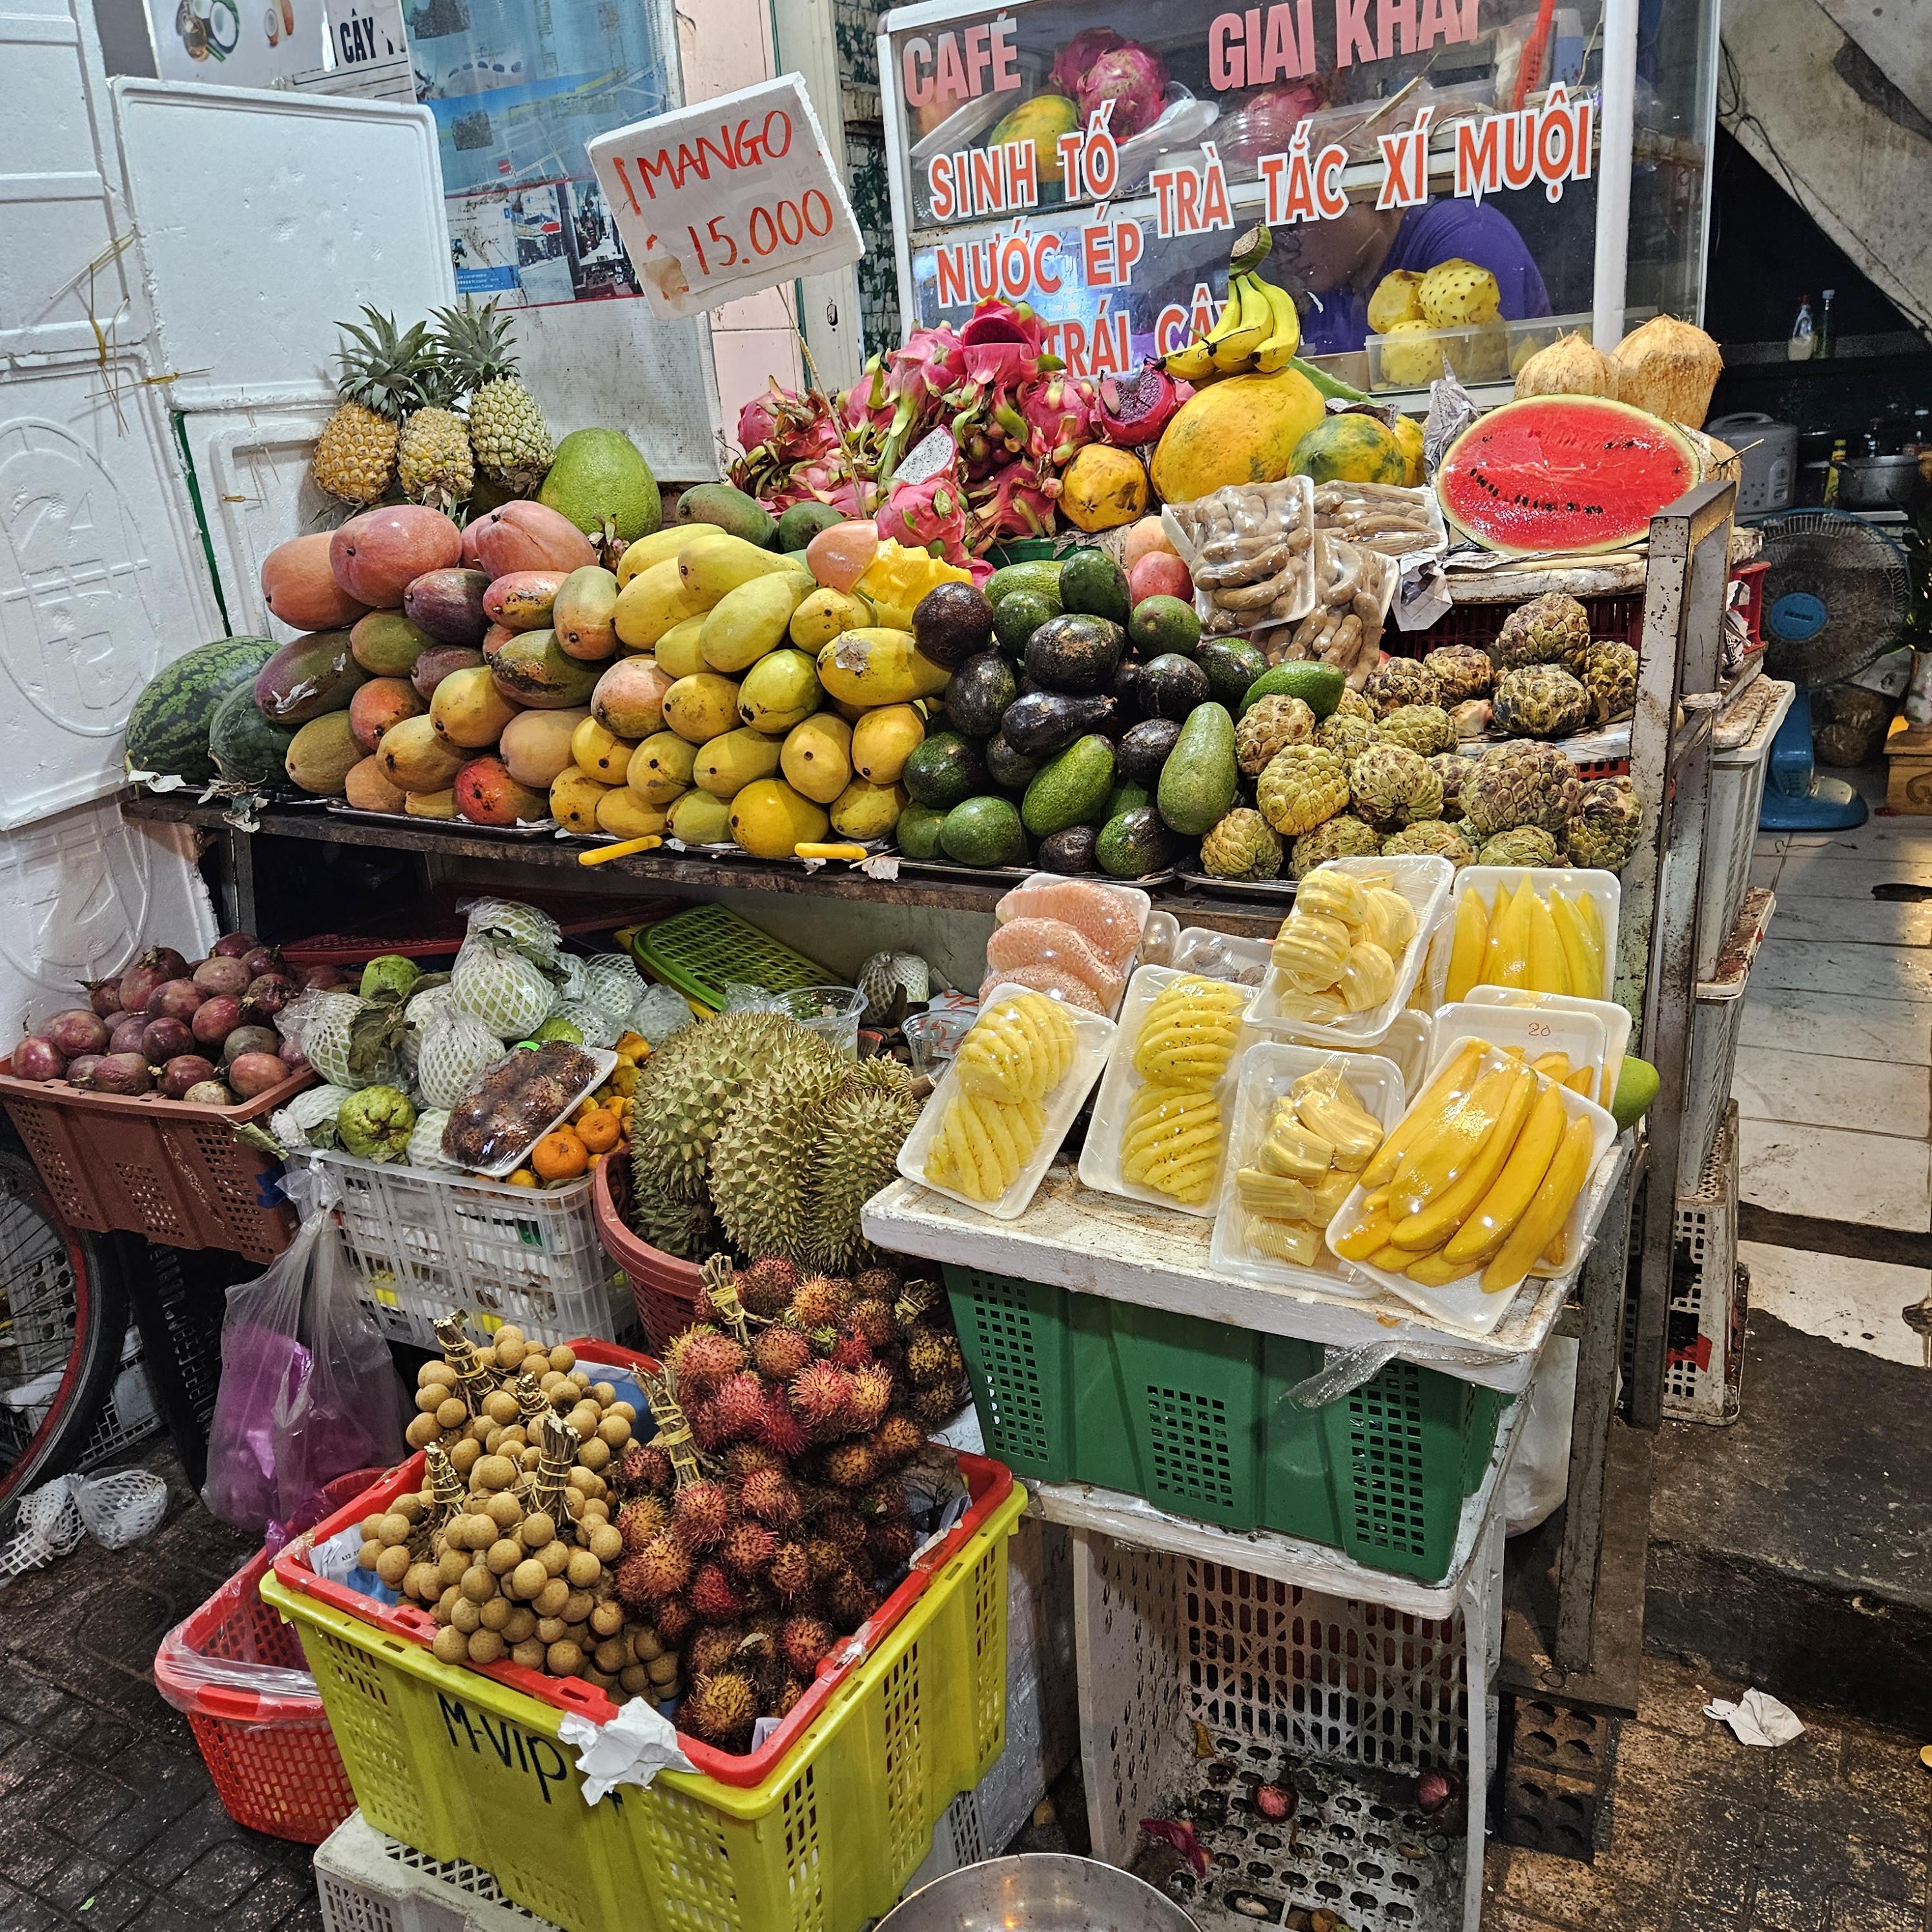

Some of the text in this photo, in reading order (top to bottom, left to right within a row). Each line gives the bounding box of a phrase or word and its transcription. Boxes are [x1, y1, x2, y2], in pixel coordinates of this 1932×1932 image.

[340, 8, 376, 64] CÂY
[903, 10, 1022, 107] CAFÉ
[637, 110, 792, 199] MANGO
[930, 101, 1117, 219] SINH TỐ
[1152, 83, 1592, 237] TRÀ TẮC XÍ MUỘI
[688, 189, 833, 275] 15.000
[936, 203, 1142, 307] NƯỚC ÉP
[1528, 1022, 1551, 1036] 20
